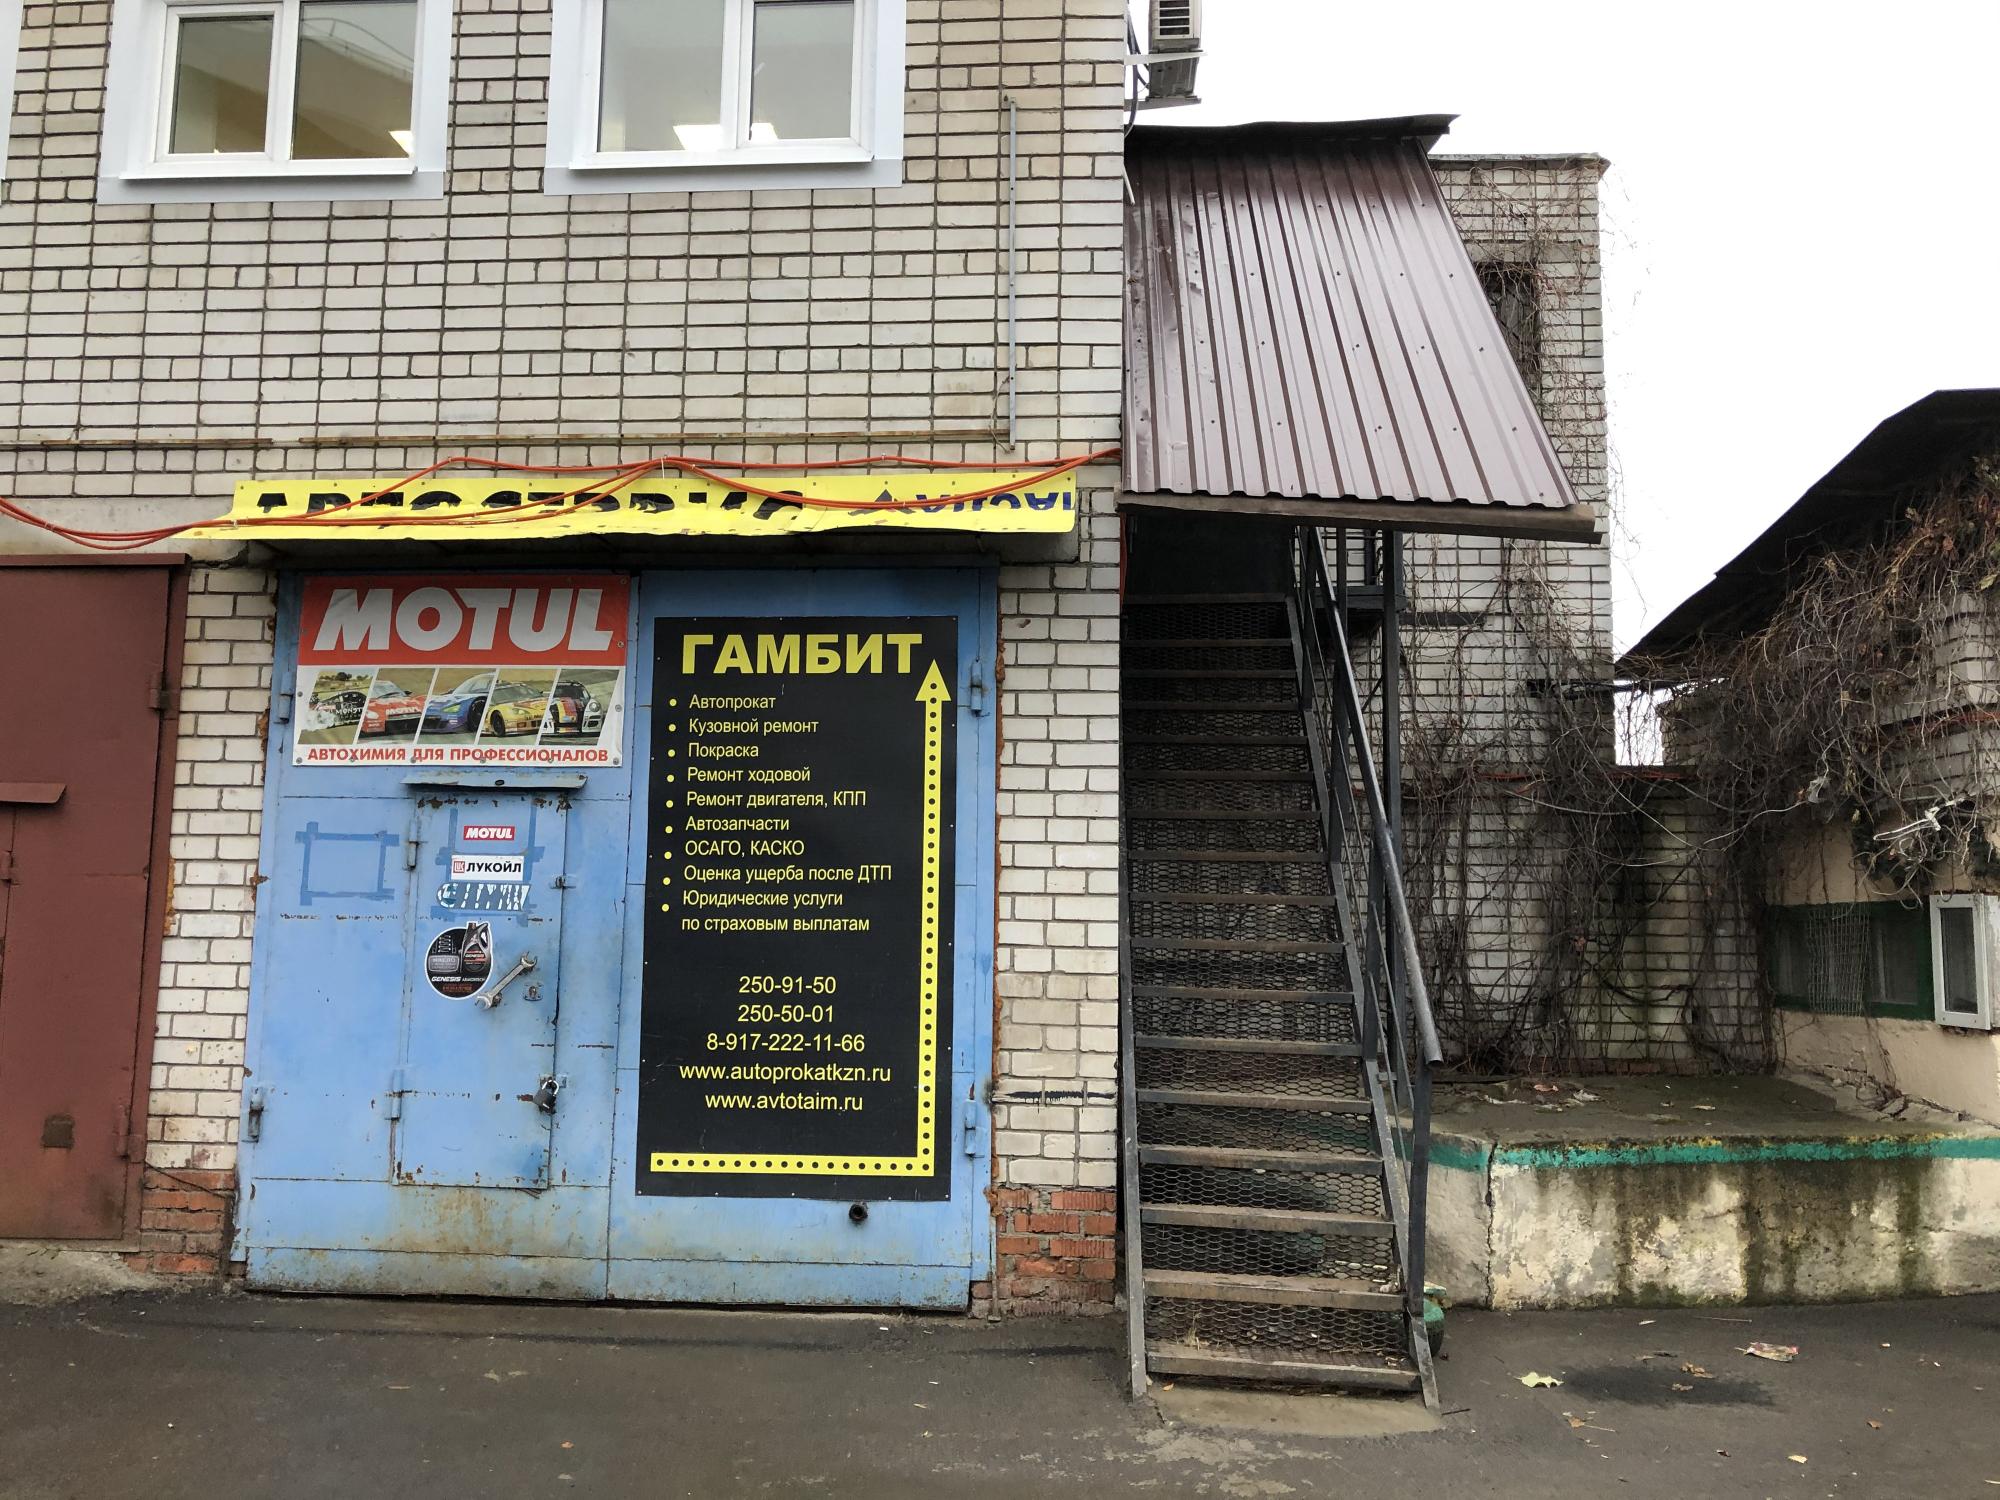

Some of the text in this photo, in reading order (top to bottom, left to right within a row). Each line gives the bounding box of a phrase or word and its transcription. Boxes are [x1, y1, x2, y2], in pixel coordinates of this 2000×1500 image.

[312, 587, 614, 652] MOTUL
[682, 634, 922, 674] ГАМБИТ
[689, 694, 776, 711] Автопрокат
[689, 718, 818, 736] Кузовной ремонт
[308, 748, 608, 763] АВТОХИМИЯ ДЛЯ ПРОФЕССИОНАЛОВ
[688, 742, 758, 760] Покраска
[688, 767, 810, 783] Ремонт ходовой
[687, 791, 866, 809] Ремонт двигателя, КПП
[465, 827, 513, 839] MOTUL
[686, 816, 789, 833] Автозапчасти
[685, 840, 804, 858] ОСАГО, КАСКО
[466, 861, 521, 872] ЛУКОЙЛ
[684, 865, 892, 884] Оценка ущерба после ДТП
[683, 890, 842, 909] Юридические услуги
[682, 918, 869, 934] по страховым выплатам
[739, 976, 836, 994] 250-91-50
[738, 1005, 834, 1022] 250-50-01
[707, 1033, 864, 1052] 8-917-222-11-66
[680, 1064, 891, 1084] www.autoprokatkzn.ru
[706, 1092, 863, 1110] www.avtotaim.ru
